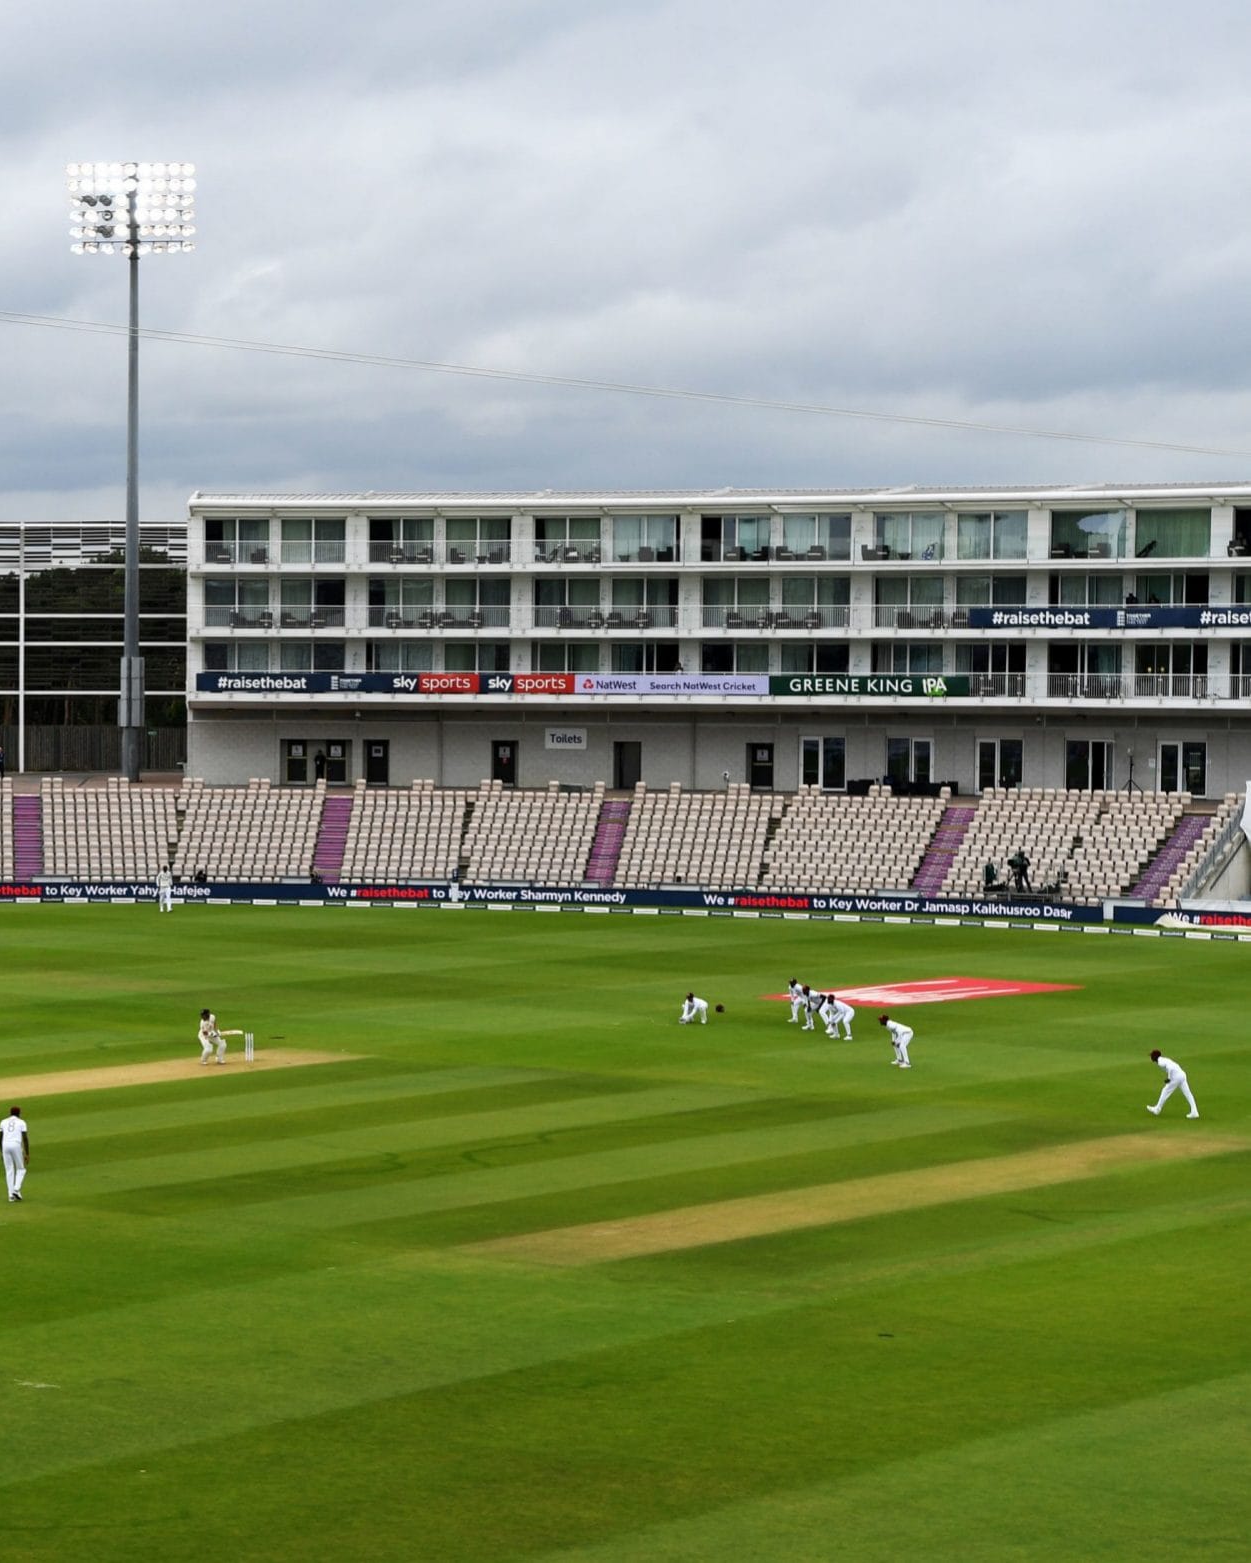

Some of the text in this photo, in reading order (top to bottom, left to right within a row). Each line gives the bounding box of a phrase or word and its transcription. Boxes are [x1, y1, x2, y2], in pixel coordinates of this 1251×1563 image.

[992, 611, 1090, 625] #raisethebat
[217, 676, 307, 690] #raisethebat
[393, 676, 470, 691] sky sports
[488, 676, 566, 692] sky sports
[596, 679, 637, 690] NatWest
[650, 681, 756, 691] Search NatWest Cricket
[789, 677, 947, 692] GREENE KING IPA
[550, 733, 582, 744] Toilets
[45, 886, 58, 896] to
[60, 885, 82, 898] Key
[84, 885, 127, 896] Worker
[130, 885, 159, 898] Yahy
[327, 887, 626, 904] We #raisethebat to ey Worker Sharmyn Kennedy
[703, 895, 724, 905] We
[728, 895, 809, 908] #raisethebat
[813, 898, 826, 908] to
[829, 898, 852, 911] Key
[855, 899, 902, 911] Worker
[904, 901, 919, 911] Dr
[921, 902, 970, 916] Jamasp
[972, 902, 1040, 917] Kaikhusroo
